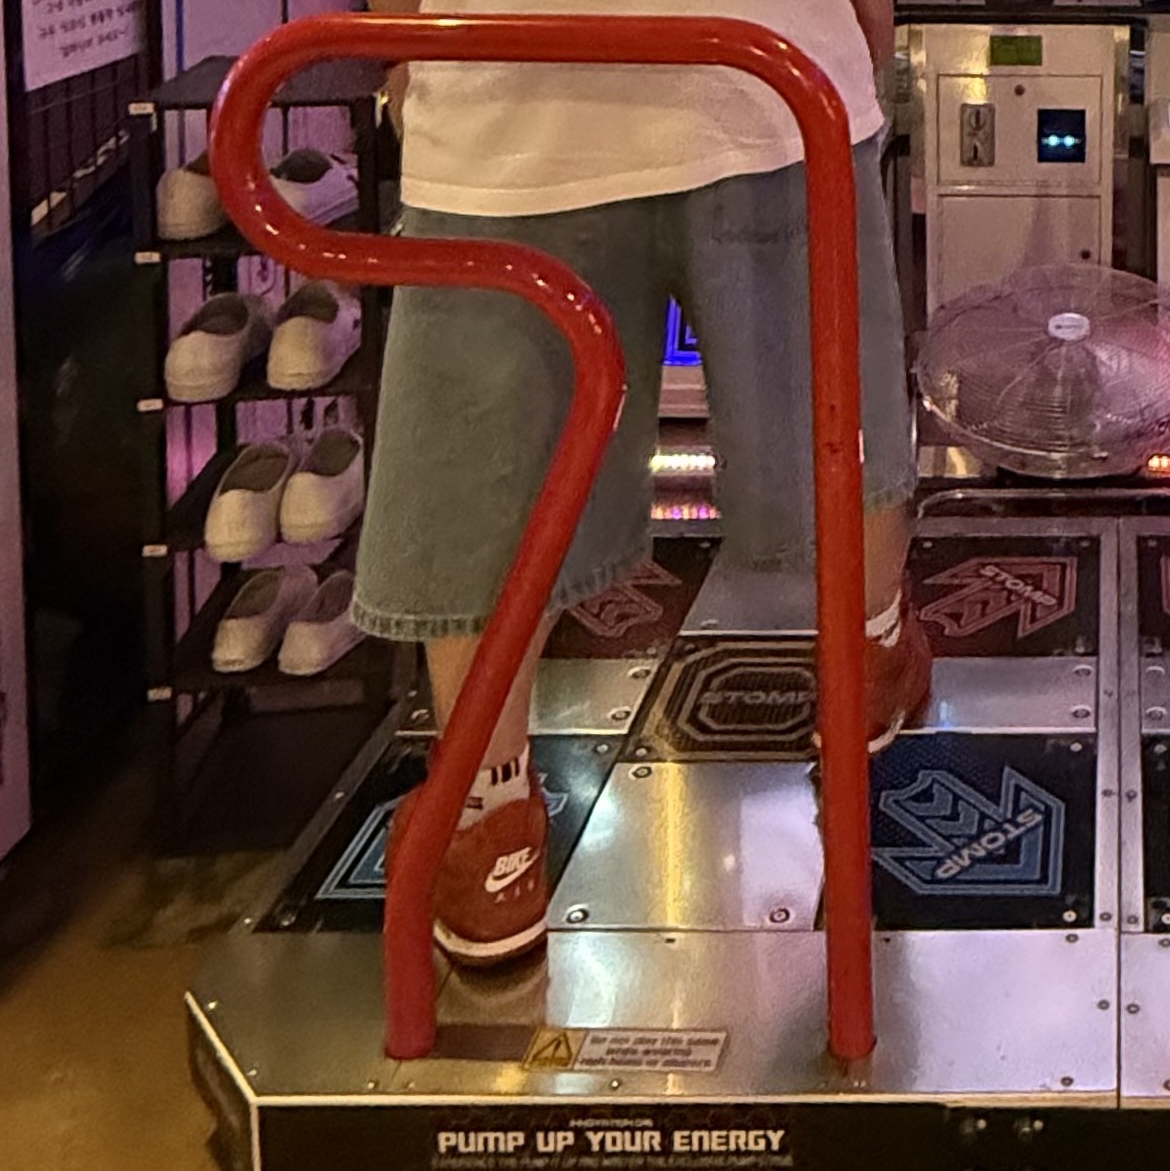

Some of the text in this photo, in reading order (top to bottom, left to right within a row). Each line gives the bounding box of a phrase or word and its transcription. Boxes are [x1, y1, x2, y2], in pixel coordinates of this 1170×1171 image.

[979, 564, 1058, 606] STOMP
[935, 808, 1043, 879] STOMP
[438, 1130, 785, 1153] PUMP UP YOUR ENERGY
